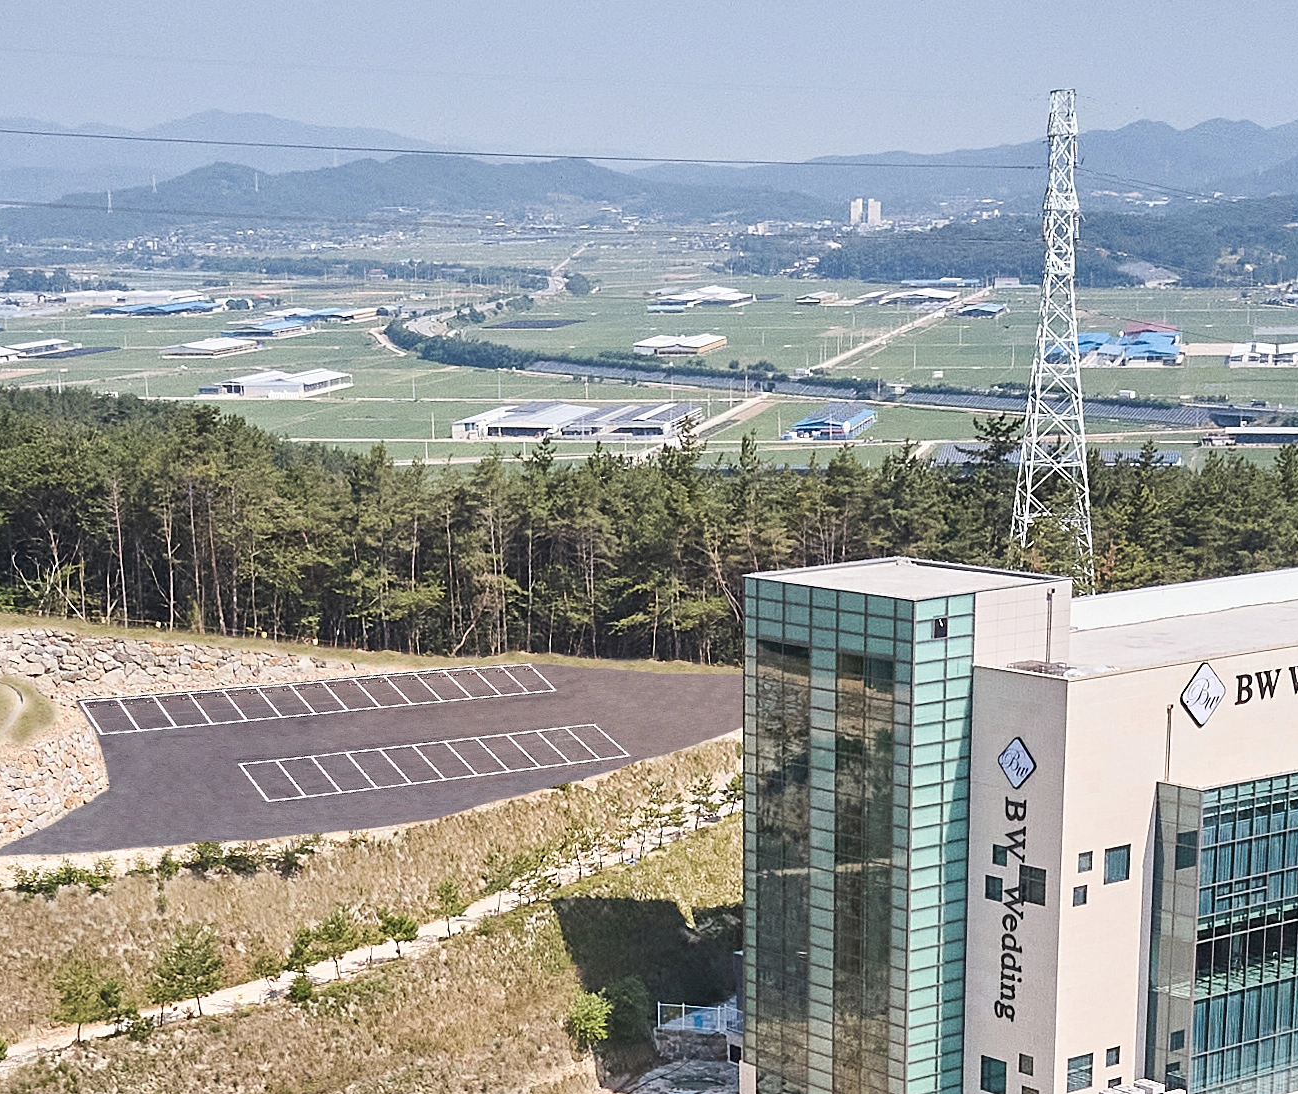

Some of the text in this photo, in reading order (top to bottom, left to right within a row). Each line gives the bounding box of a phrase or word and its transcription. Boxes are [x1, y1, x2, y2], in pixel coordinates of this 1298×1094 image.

[1234, 668, 1282, 706] BW
[993, 796, 1027, 1023] BW Wedding
